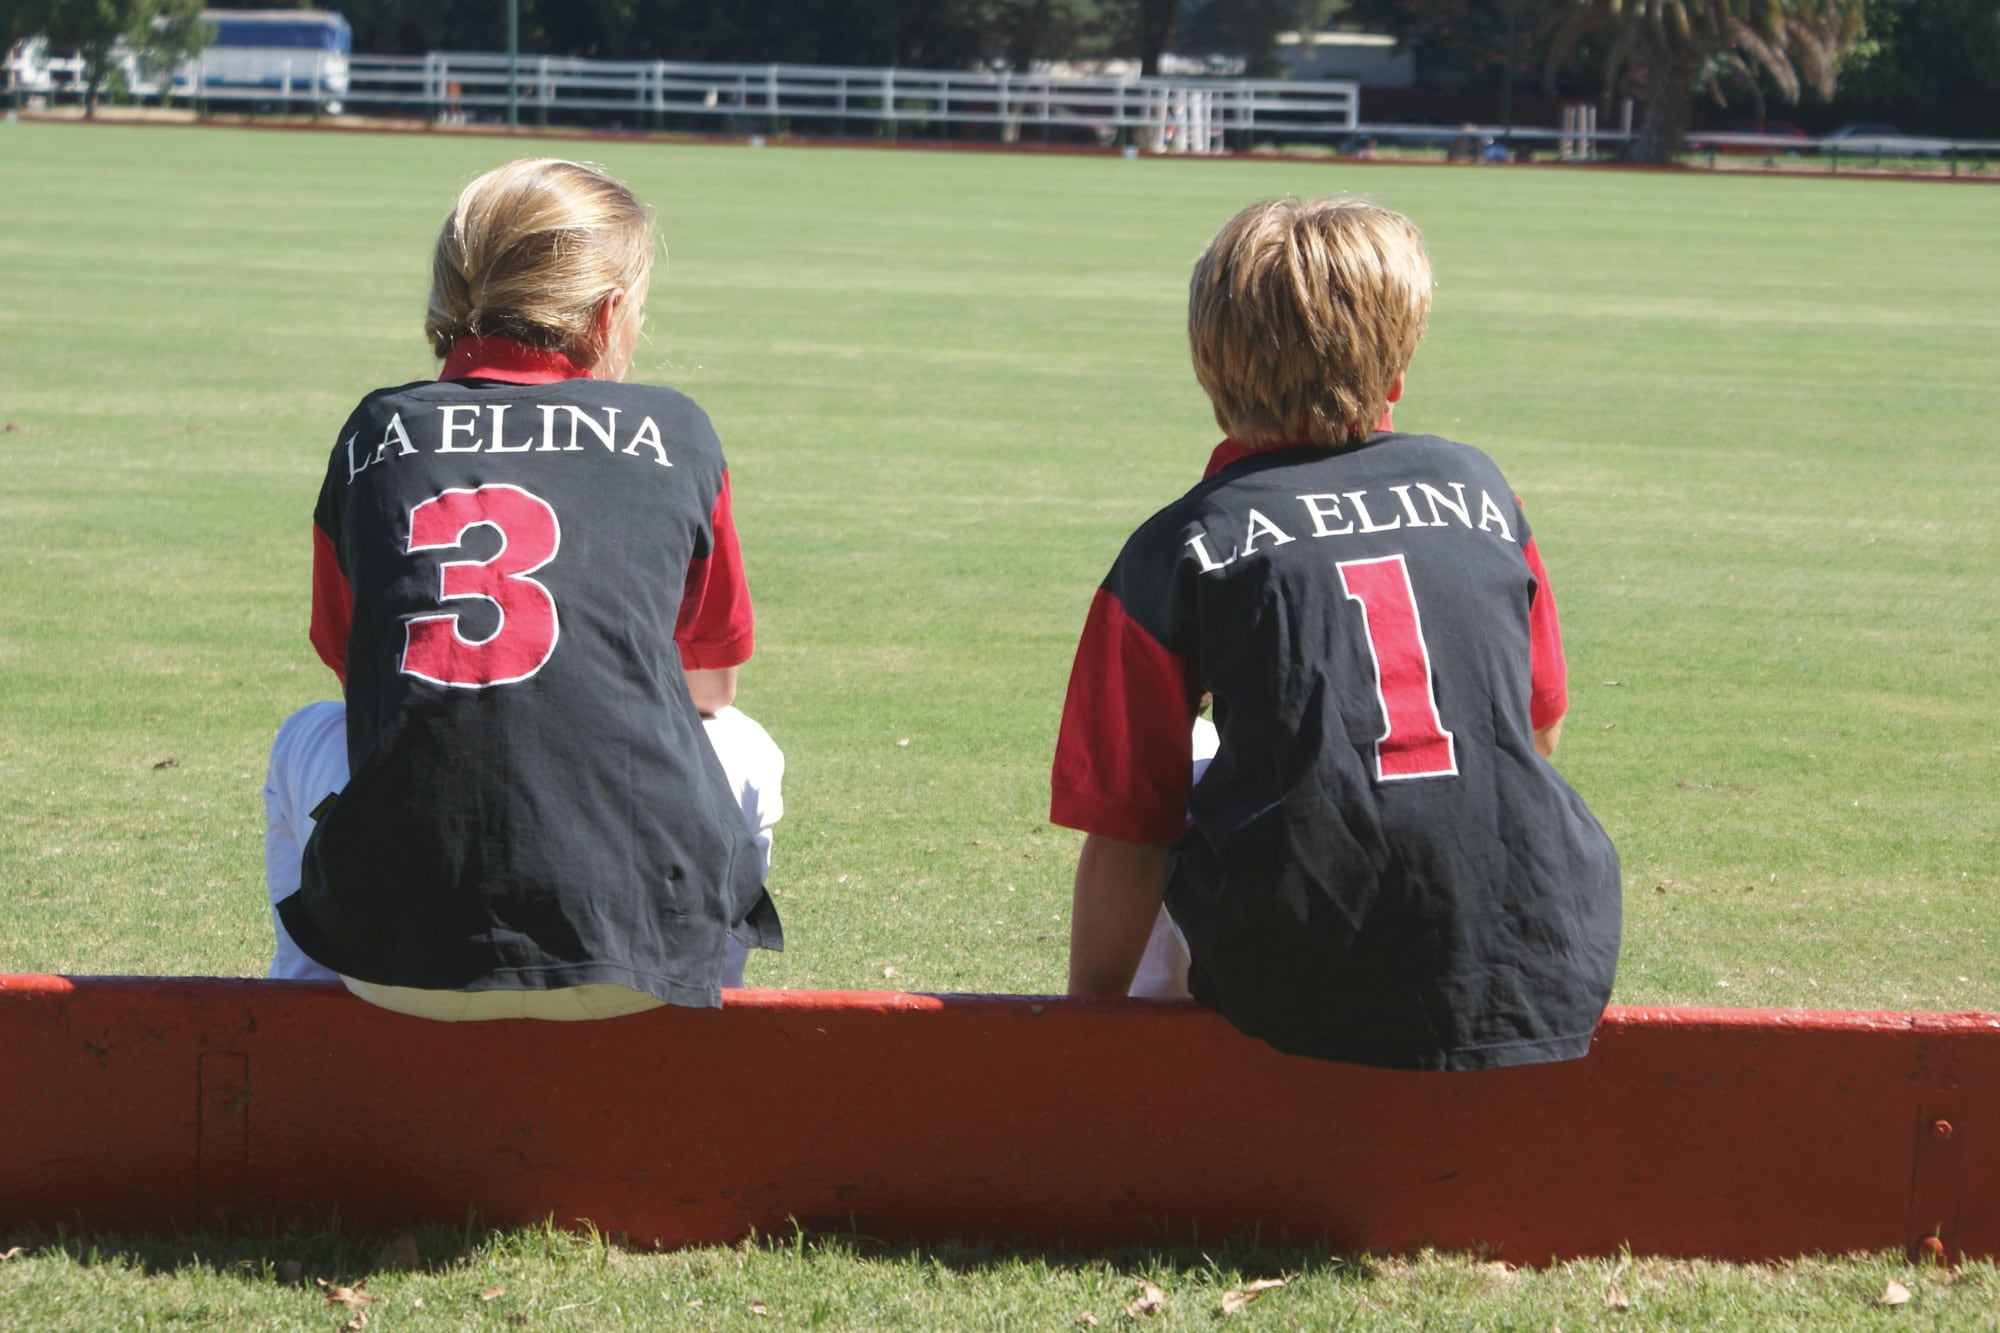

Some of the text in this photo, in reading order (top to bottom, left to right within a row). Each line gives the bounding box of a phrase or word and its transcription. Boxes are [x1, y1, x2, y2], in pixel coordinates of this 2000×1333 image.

[345, 404, 673, 485] LA ELINA
[401, 483, 561, 689] 3
[1185, 482, 1516, 574] LA ELINA
[1335, 553, 1459, 782] 1
